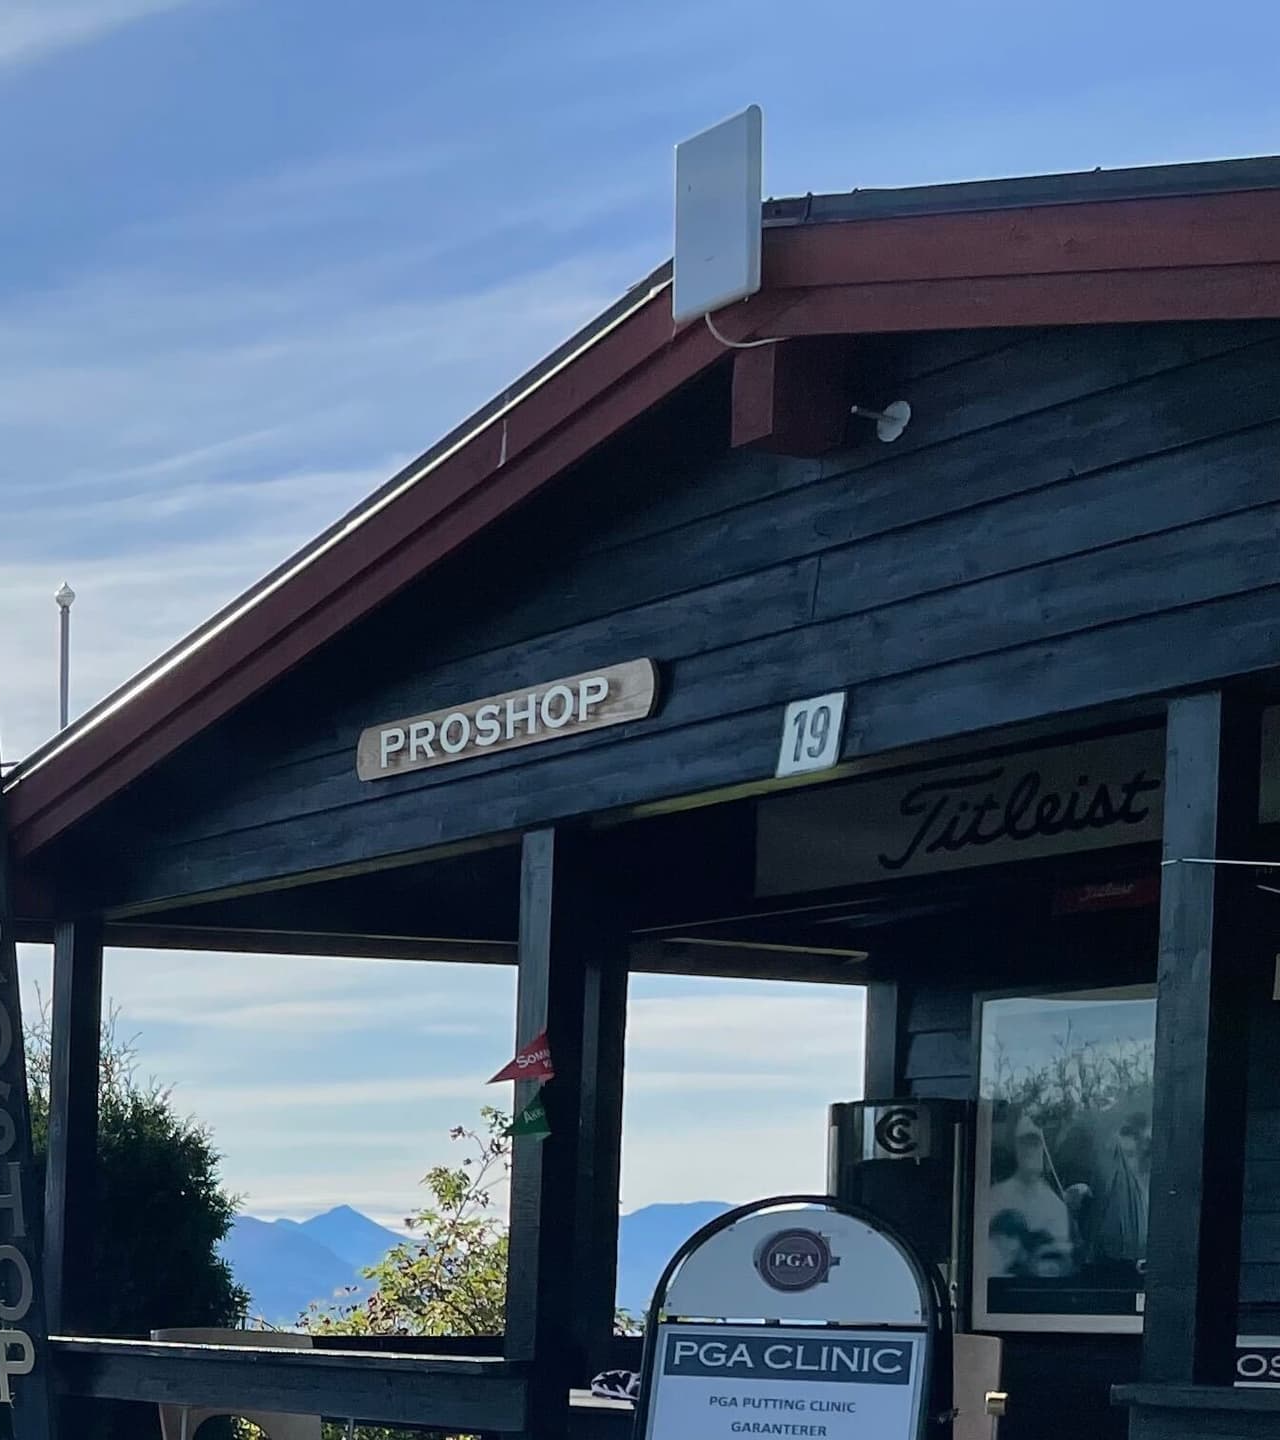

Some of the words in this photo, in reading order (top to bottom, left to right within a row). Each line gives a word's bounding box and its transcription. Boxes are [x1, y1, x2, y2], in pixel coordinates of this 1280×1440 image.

[379, 676, 609, 769] PROSHOP
[792, 704, 831, 763] 19
[878, 767, 1162, 870] Titleist
[774, 1252, 816, 1268] PGA
[673, 1341, 754, 1369] PGA
[763, 1344, 903, 1375] CLINIC
[709, 1395, 738, 1408] PGA
[742, 1397, 805, 1412] PUTTING
[809, 1400, 857, 1413] CLINIC
[730, 1421, 827, 1437] GARANTERER
